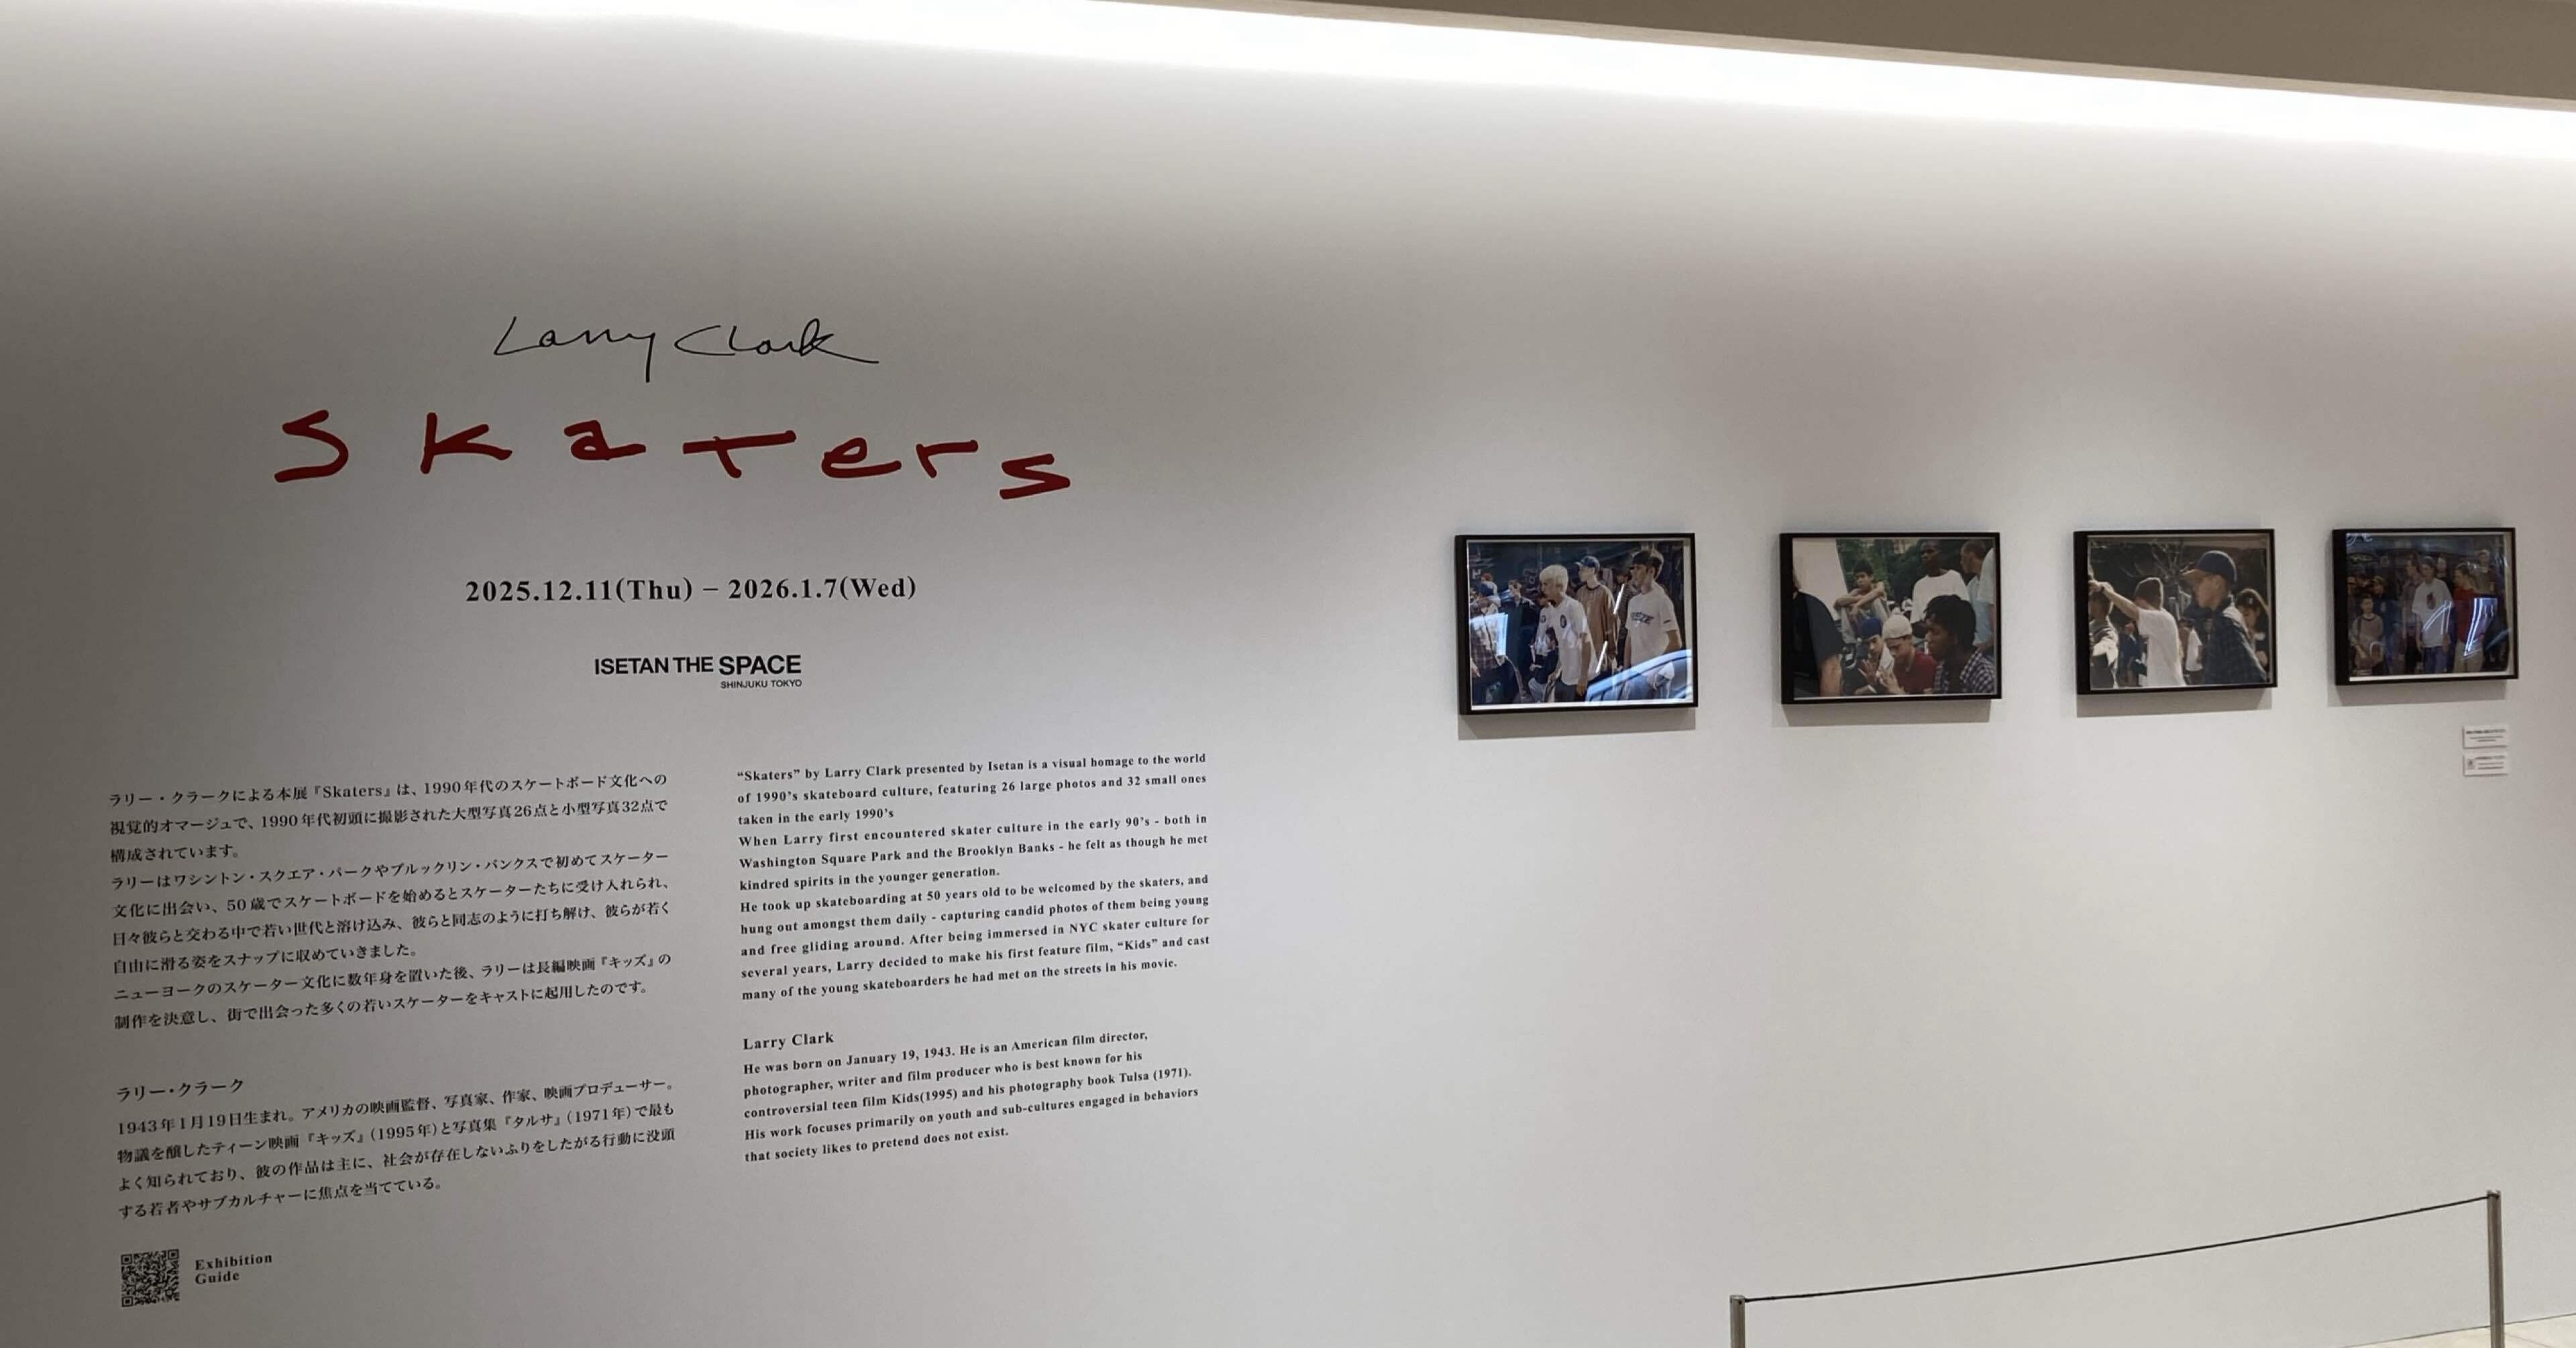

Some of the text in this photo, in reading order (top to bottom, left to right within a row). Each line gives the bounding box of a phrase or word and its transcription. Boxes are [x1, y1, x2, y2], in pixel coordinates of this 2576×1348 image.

[466, 576, 693, 603] 2025.12.11(Thu)
[728, 575, 916, 601] 2026.1.7(Wed)
[594, 654, 802, 676] ISETAN THE SPACE
[720, 678, 802, 689] SHINJUKU TOKYO
[805, 768, 820, 782] by
[824, 767, 861, 780] Larry
[865, 765, 902, 776] Clark
[906, 762, 965, 778] presented
[969, 762, 983, 775] by
[988, 761, 1024, 772] Isetan
[1028, 760, 1038, 770] is
[1052, 758, 1086, 768] visual
[1090, 757, 1134, 768] homage
[1138, 756, 1149, 766] to
[1152, 754, 1171, 765] the
[1173, 753, 1206, 764] world
[737, 792, 752, 804] of
[803, 786, 877, 800] skateboard
[881, 786, 933, 797] culture,
[938, 782, 997, 795] featuring
[1002, 781, 1016, 792] 26
[1020, 780, 1052, 793] large
[1056, 779, 1096, 792] photos
[1101, 776, 1122, 787] and
[1127, 776, 1140, 786] 32
[1144, 774, 1177, 786] small
[1181, 775, 1206, 784] ones
[738, 814, 773, 825] taken
[778, 813, 790, 824] in
[794, 812, 815, 823] the
[818, 810, 851, 823] early
[110, 843, 238, 864] 構成されています。
[739, 866, 1000, 891] kindred spirits in the younger generation.
[740, 874, 1208, 913] He took up skateboarding at 50 years old to be welcomed by the skaters, and
[742, 958, 1177, 1001] many of the young skateboarders he had met on the streets in his movie.
[743, 1031, 835, 1051] Larry Clark
[743, 1031, 1148, 1075] He was born on January 19, 1943. He is an American film director,
[743, 1051, 1142, 1100] photographer, writer and film producer who is best known for his
[116, 1078, 244, 1102] ラリー・クラーク
[744, 1067, 1192, 1119] controversial teen film Kids(1995) and his photography book Tulsa (1971).
[745, 1088, 1199, 1141] His work focuses primarily on youth and sub-cultures engaged in behaviors
[745, 1127, 1009, 1163] that society likes to pretend does not exist.
[195, 1253, 272, 1268] Exhibition
[195, 1269, 240, 1286] Guide
